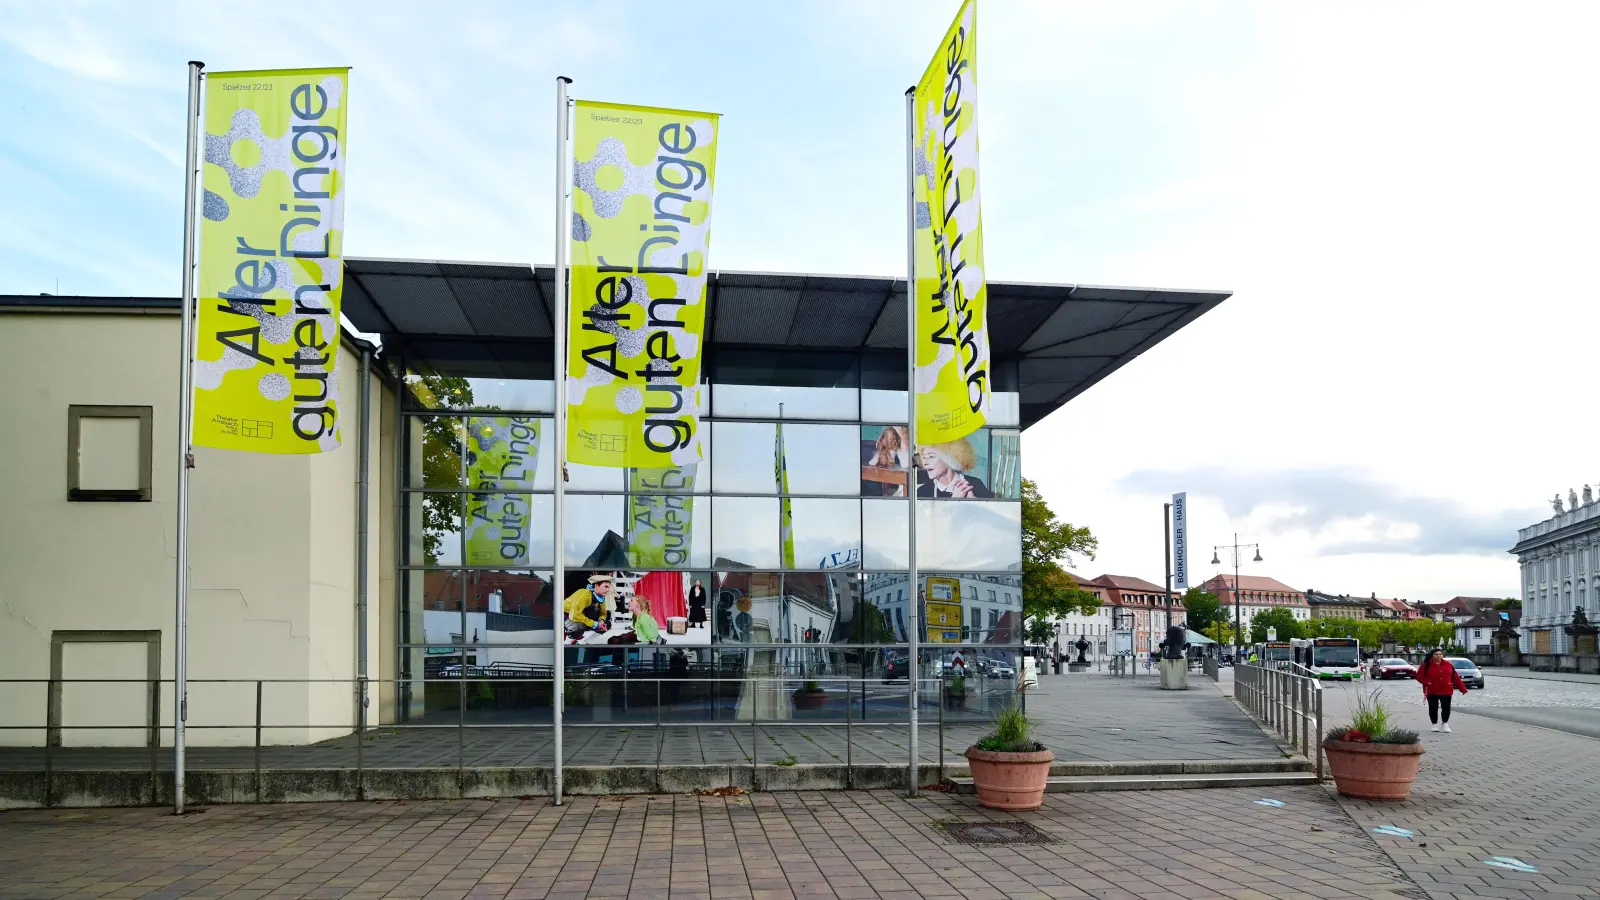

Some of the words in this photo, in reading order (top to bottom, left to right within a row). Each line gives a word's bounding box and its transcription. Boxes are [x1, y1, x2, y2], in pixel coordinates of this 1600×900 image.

[222, 83, 251, 91] Spielzeit
[253, 83, 273, 91] 22/23
[590, 112, 620, 123] Spielzeit
[622, 117, 643, 125] 22/23
[279, 83, 338, 258] Dinge
[637, 122, 706, 275] Dinge
[282, 283, 335, 441] guten
[581, 255, 633, 380] Aller
[635, 297, 691, 453] guten
[1176, 528, 1184, 583] BORKHOLDER
